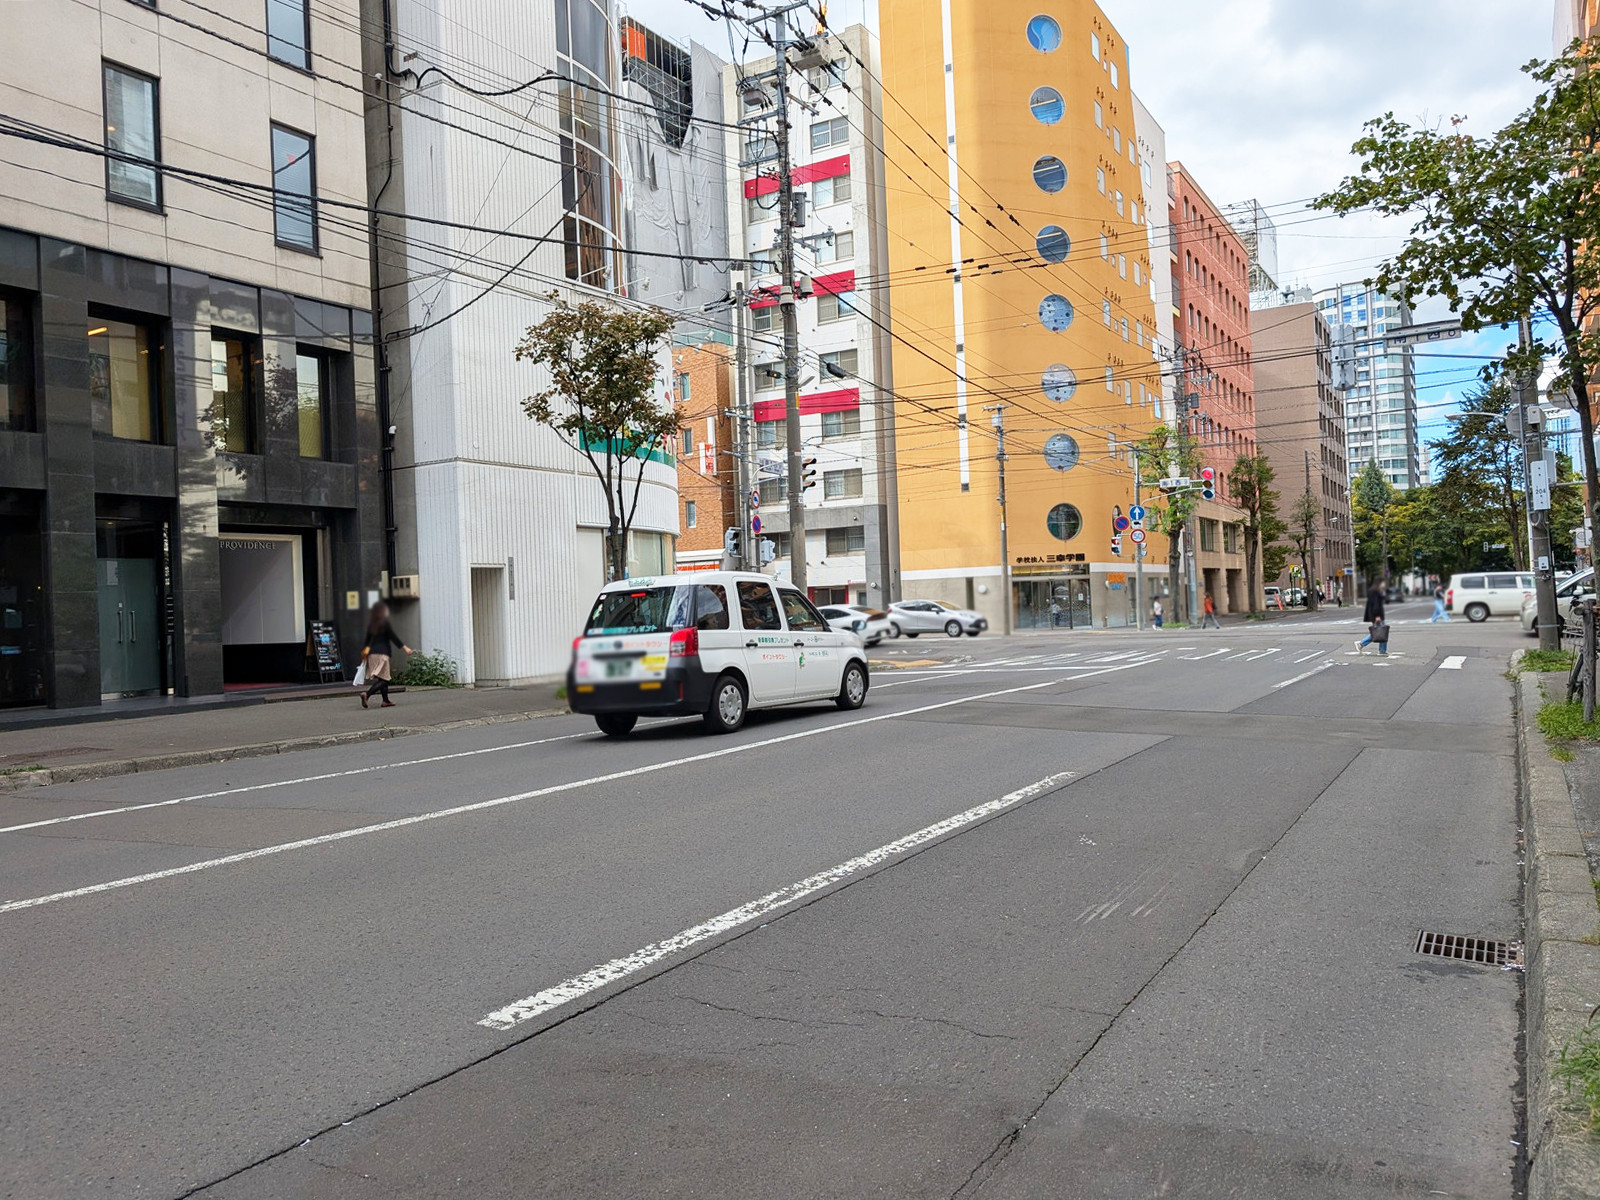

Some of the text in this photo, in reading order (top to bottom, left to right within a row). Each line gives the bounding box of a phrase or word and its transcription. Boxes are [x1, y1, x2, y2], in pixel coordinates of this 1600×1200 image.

[1133, 532, 1143, 540] 50
[220, 540, 275, 550] PROVIDENCE
[1046, 553, 1085, 563] 三幸学園
